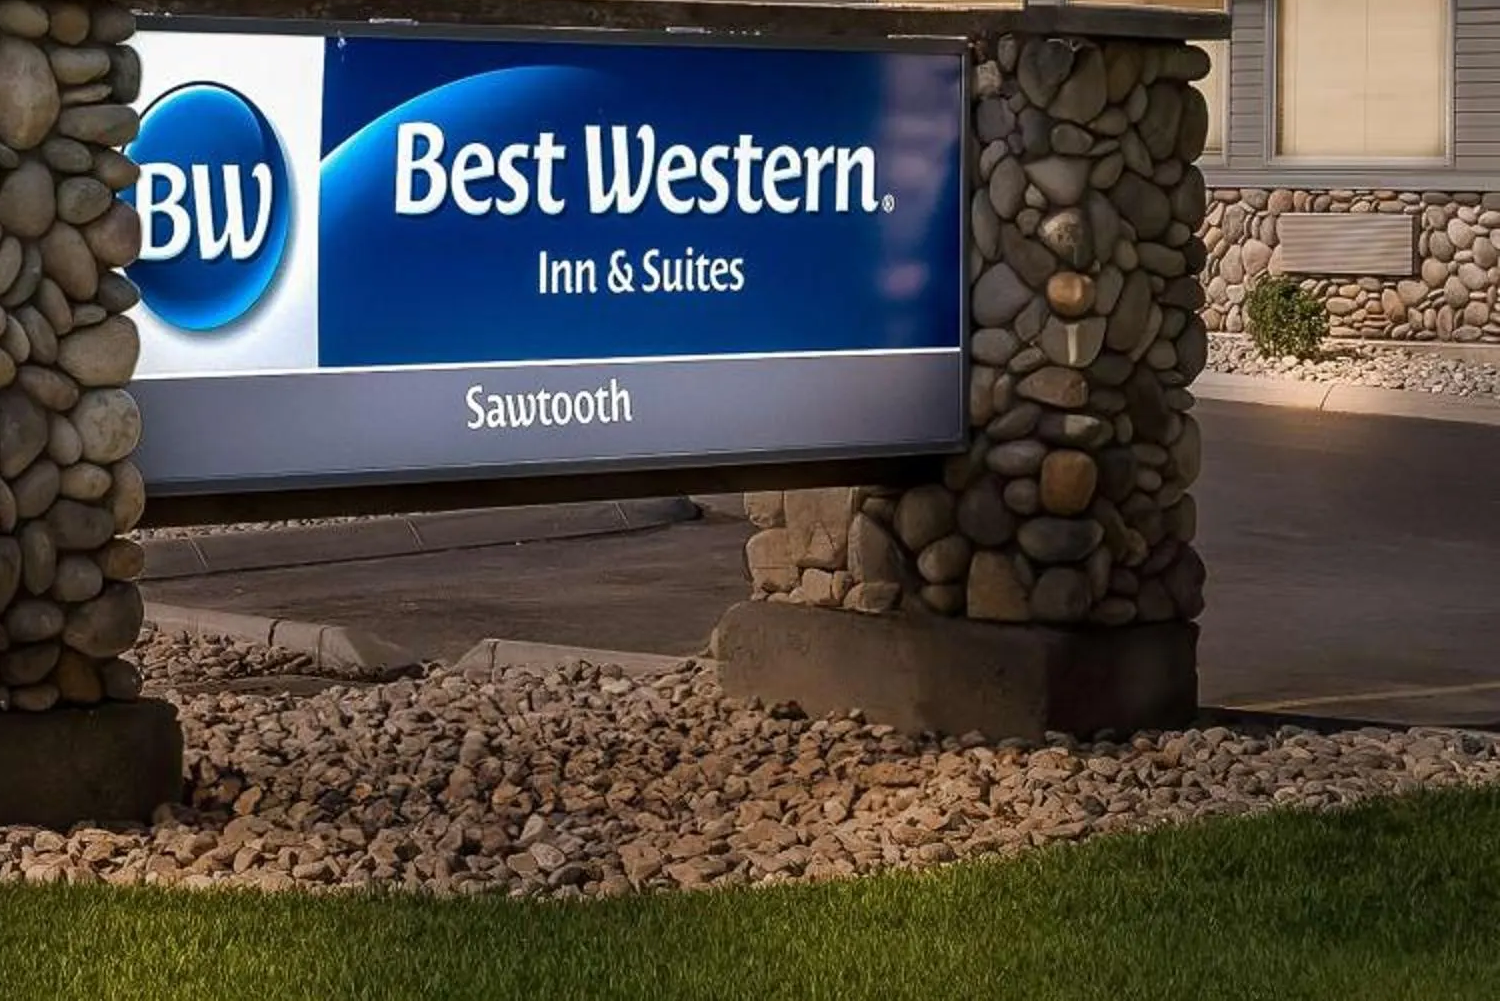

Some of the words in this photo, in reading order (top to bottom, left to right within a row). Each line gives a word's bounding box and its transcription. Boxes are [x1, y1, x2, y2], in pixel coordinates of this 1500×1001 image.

[395, 122, 565, 214] Best
[585, 124, 879, 214] Western
[135, 162, 273, 260] BW
[539, 251, 597, 294] Inn
[607, 250, 635, 293] &
[642, 246, 744, 292] Suites
[465, 378, 632, 429] Sawtooth
